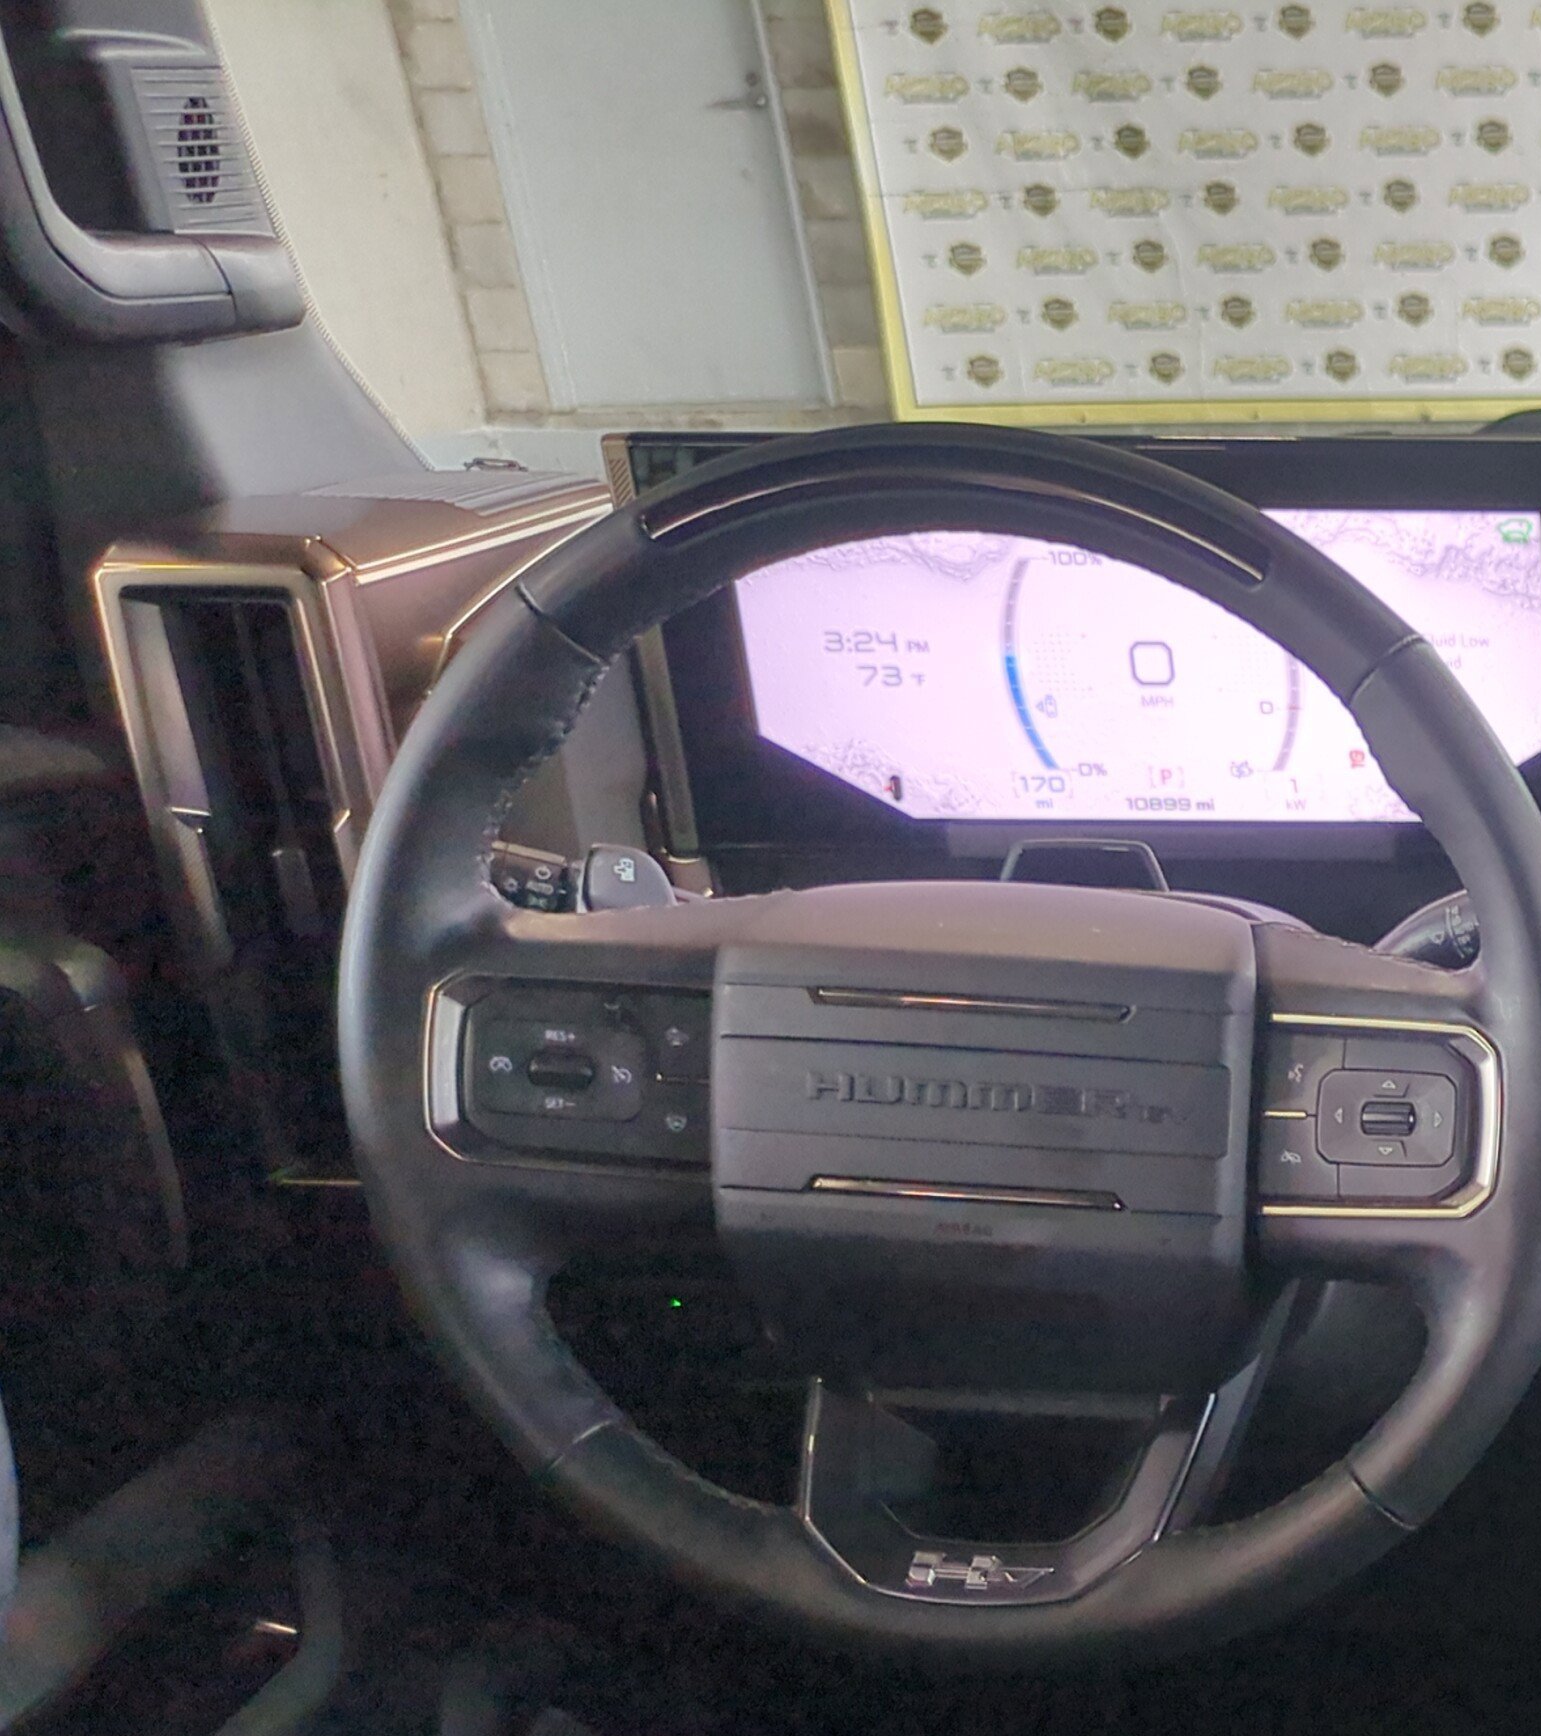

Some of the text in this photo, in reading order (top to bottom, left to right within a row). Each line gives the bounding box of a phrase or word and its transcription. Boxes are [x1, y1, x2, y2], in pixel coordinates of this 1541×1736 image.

[823, 631, 899, 653] 3:24
[856, 666, 902, 687] 73
[1140, 695, 1174, 707] MPH
[1019, 776, 1066, 794] 170
[1160, 769, 1173, 785] P
[1035, 798, 1054, 810] mi
[1125, 796, 1215, 811] 10899 mi
